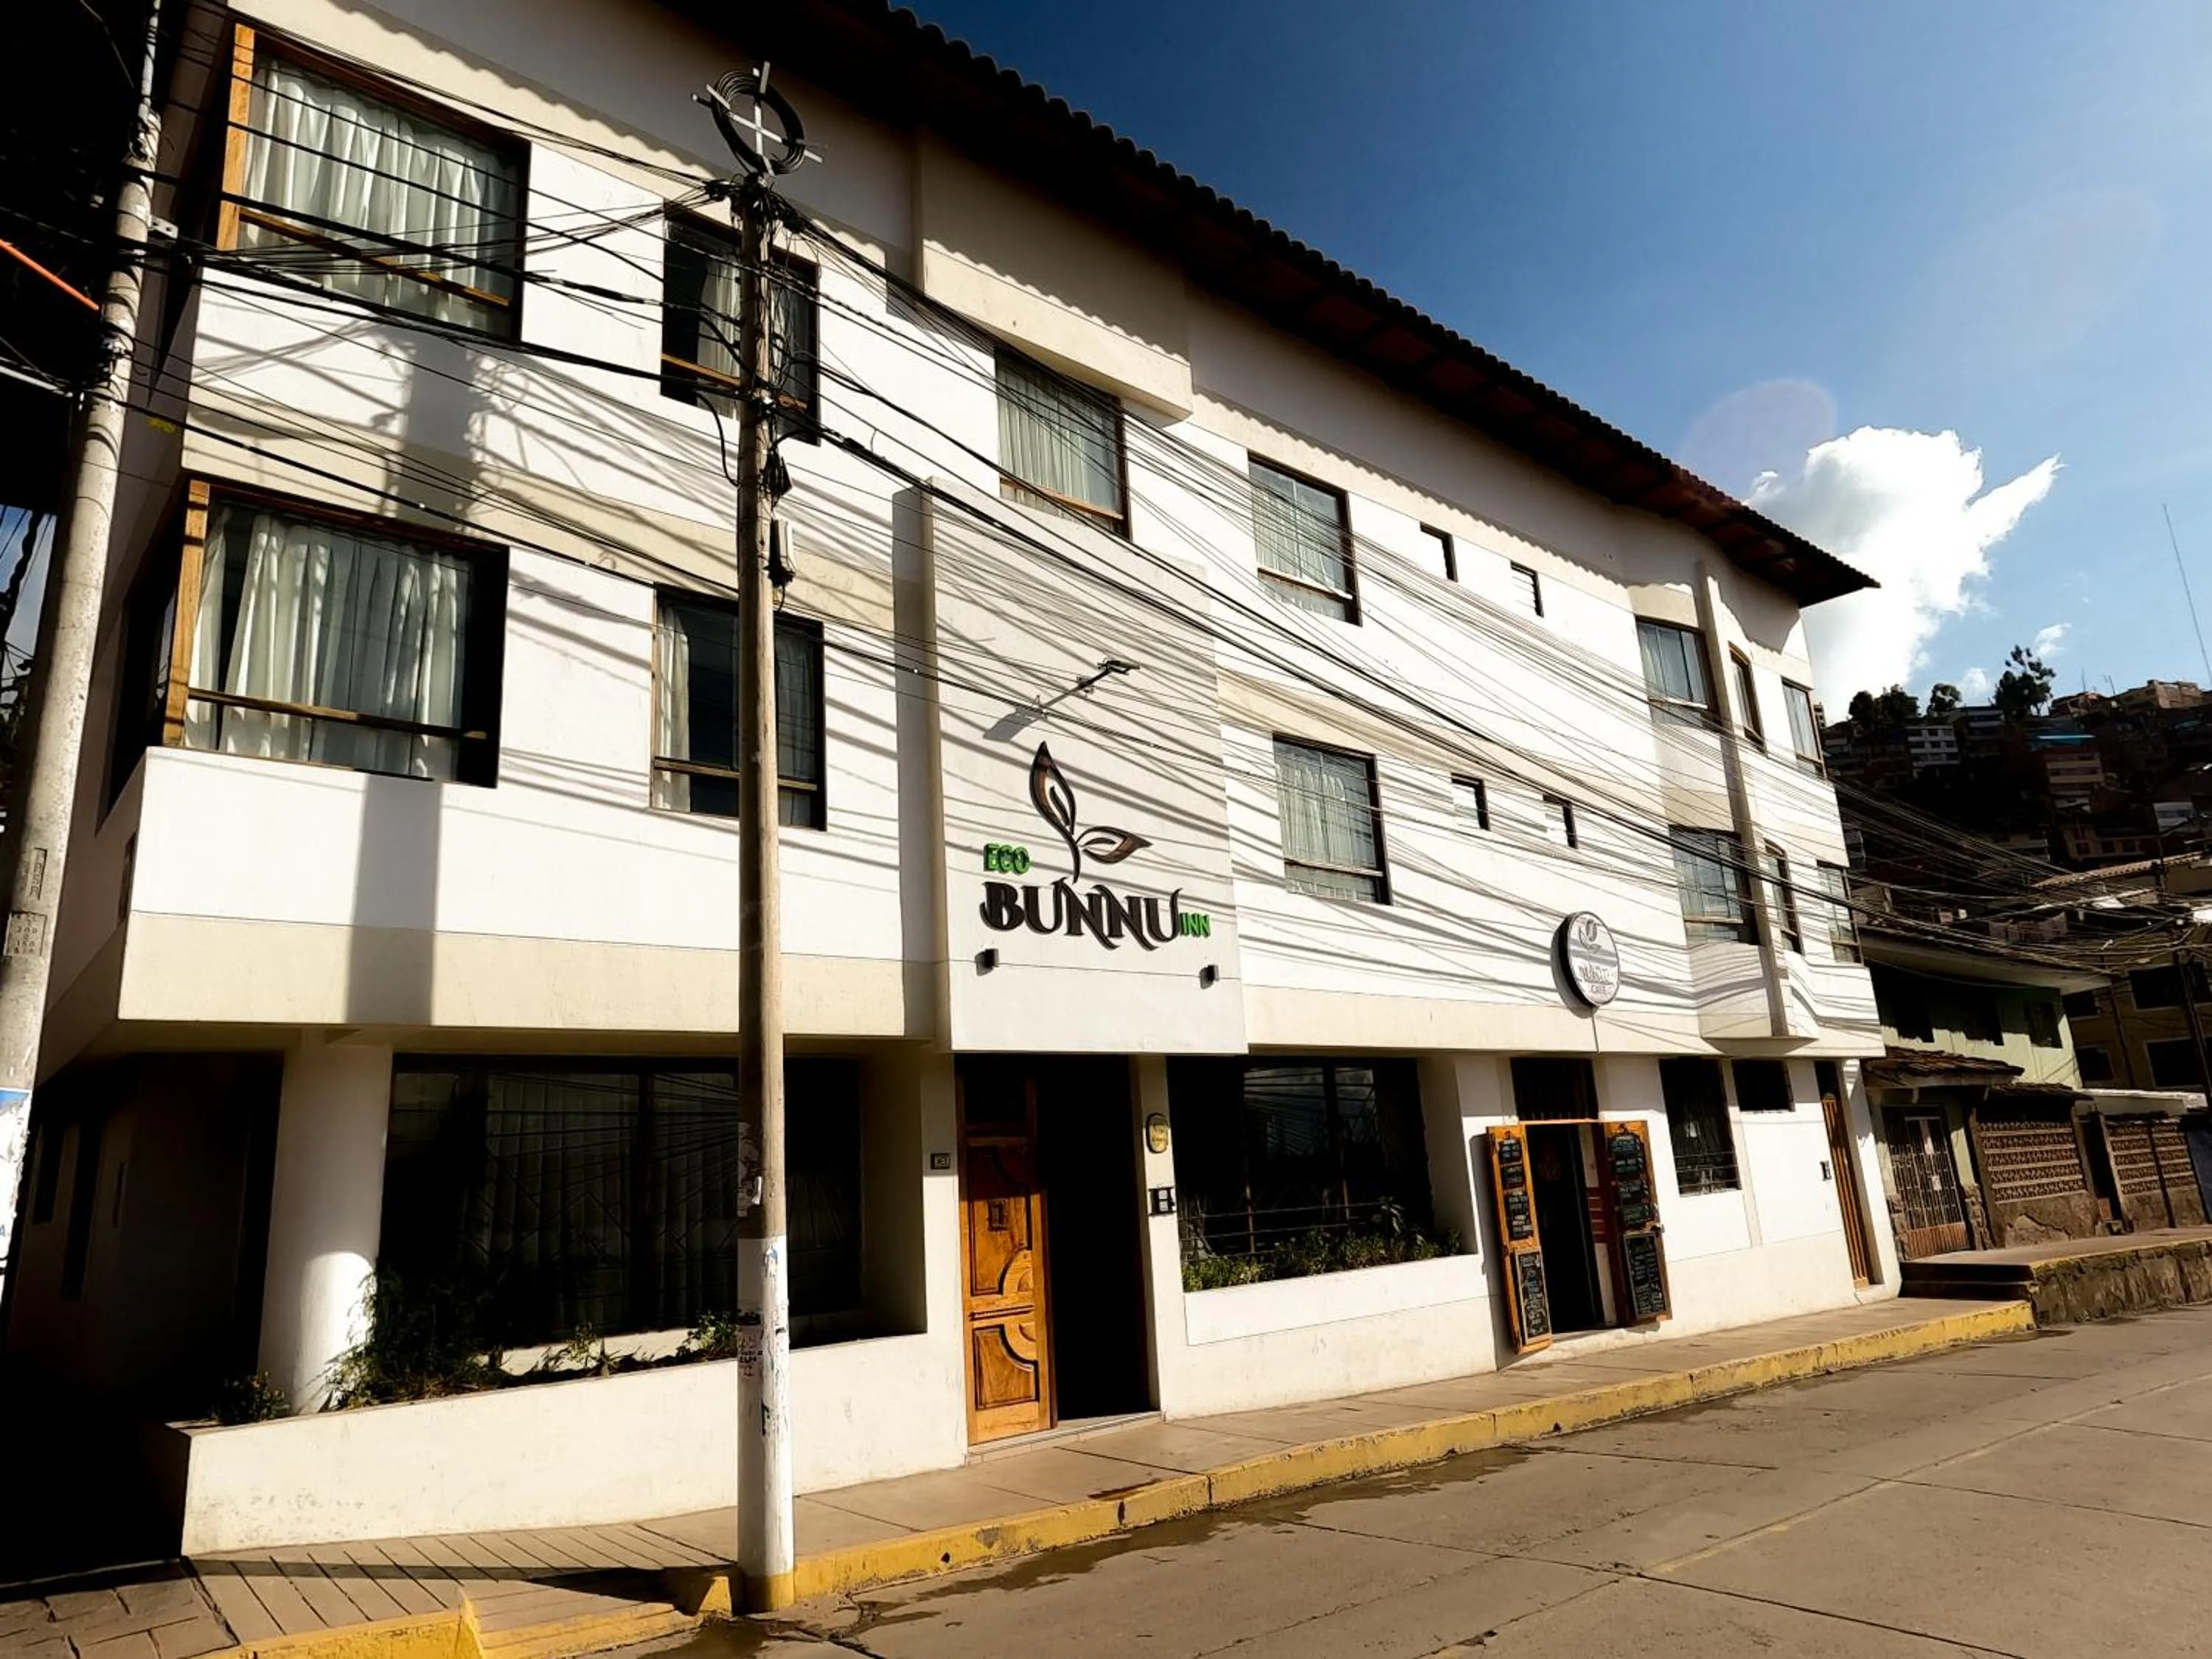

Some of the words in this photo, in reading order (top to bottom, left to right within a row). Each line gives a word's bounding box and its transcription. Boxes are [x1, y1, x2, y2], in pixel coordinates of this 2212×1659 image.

[984, 844, 1030, 874] ECO
[980, 877, 1183, 950] BUNNU
[1180, 912, 1211, 939] INN
